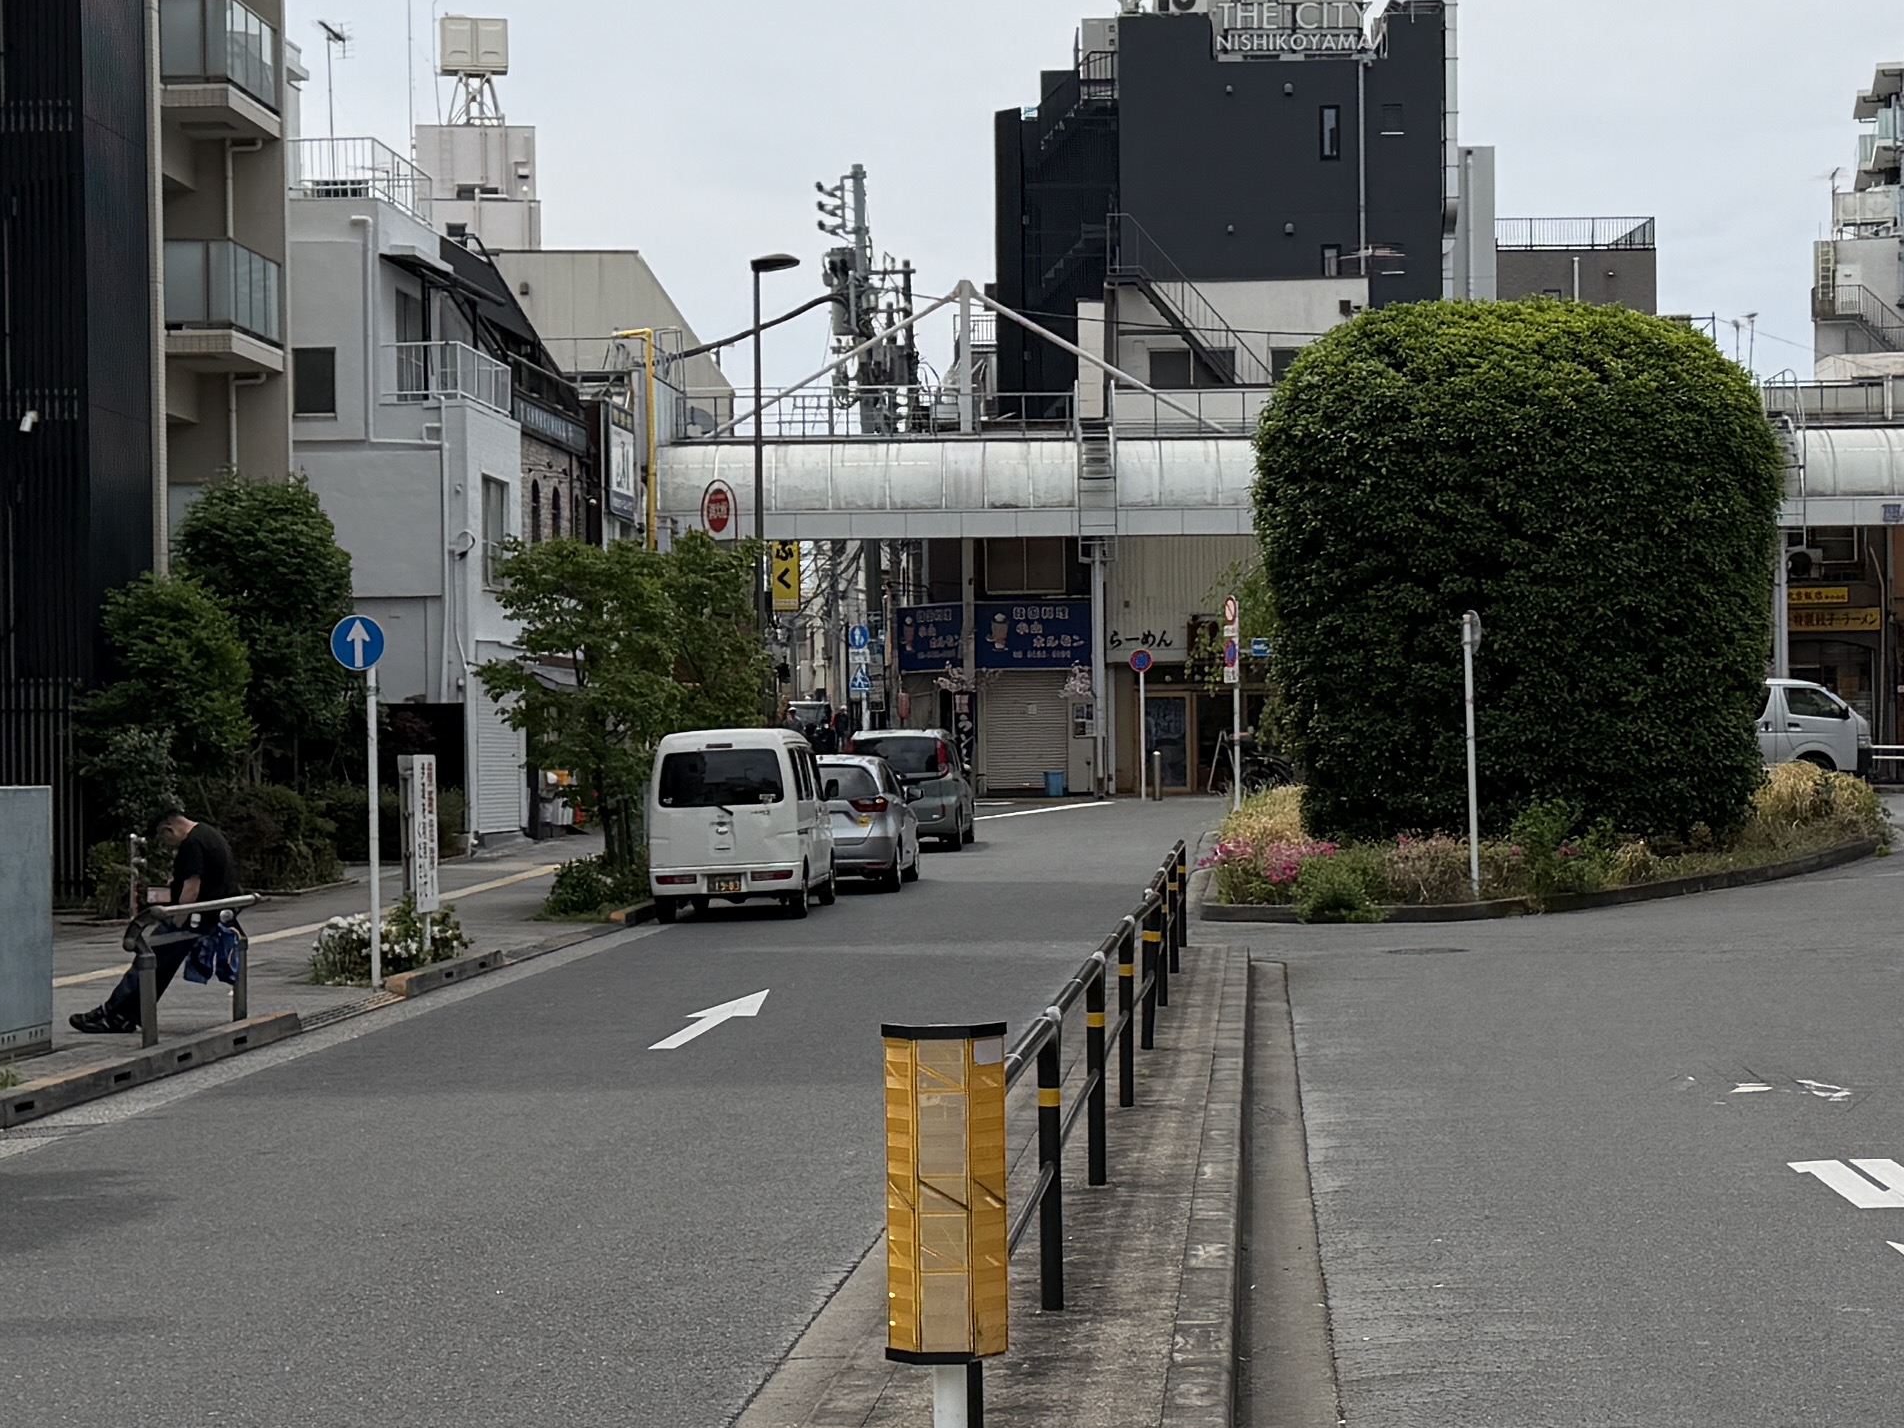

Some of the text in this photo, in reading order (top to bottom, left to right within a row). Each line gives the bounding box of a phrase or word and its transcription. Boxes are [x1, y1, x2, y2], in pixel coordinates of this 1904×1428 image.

[1217, 1, 1374, 31] THE CITY
[1216, 34, 1375, 52] NISHIKOYAMA
[1109, 630, 1173, 649] らーめん
